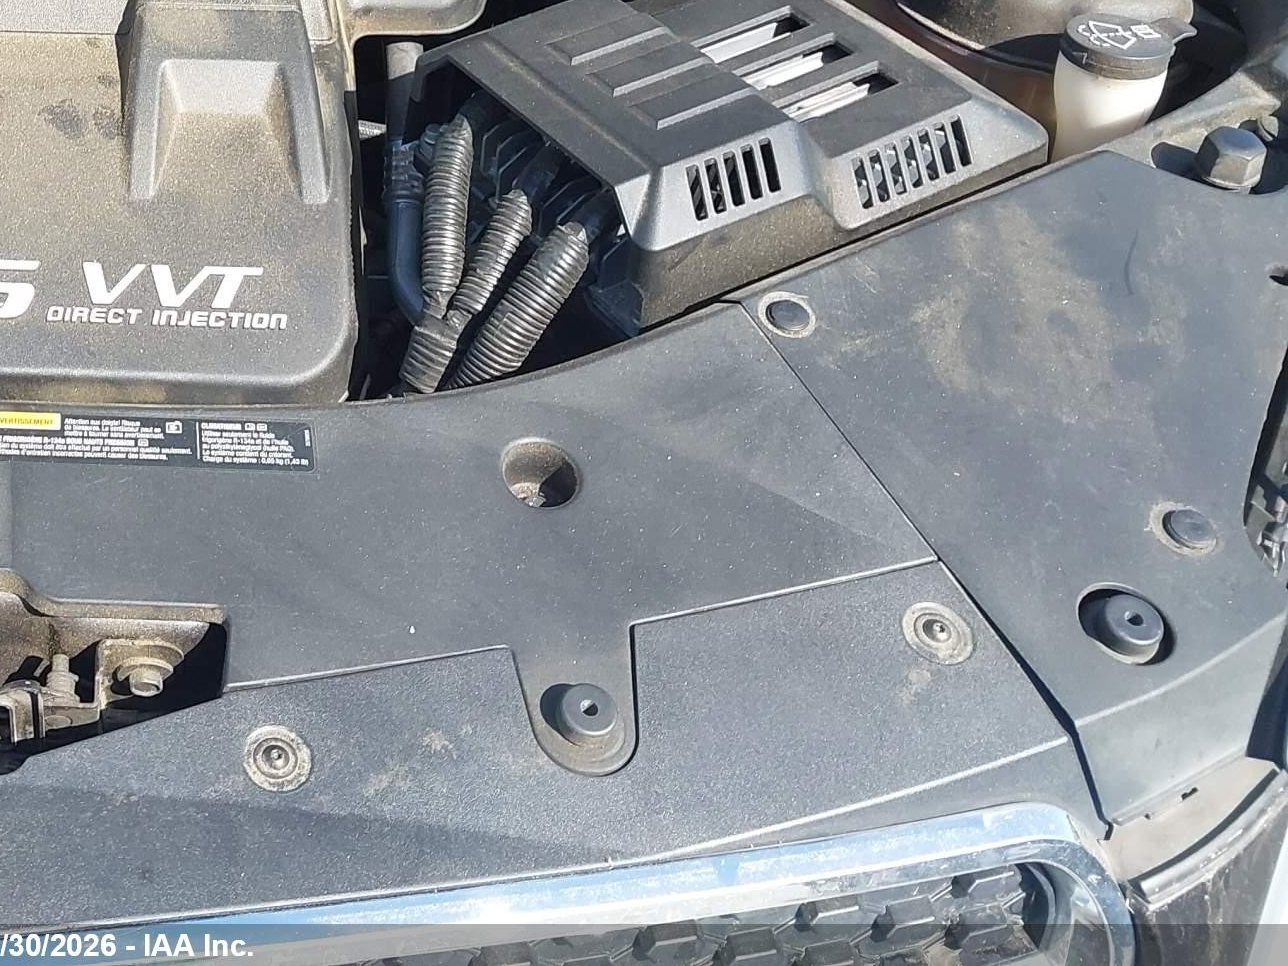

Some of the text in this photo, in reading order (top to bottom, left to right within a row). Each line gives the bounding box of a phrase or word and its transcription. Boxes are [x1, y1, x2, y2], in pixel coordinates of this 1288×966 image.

[83, 261, 263, 309] VVT
[45, 305, 288, 330] DIRECT INJECTION
